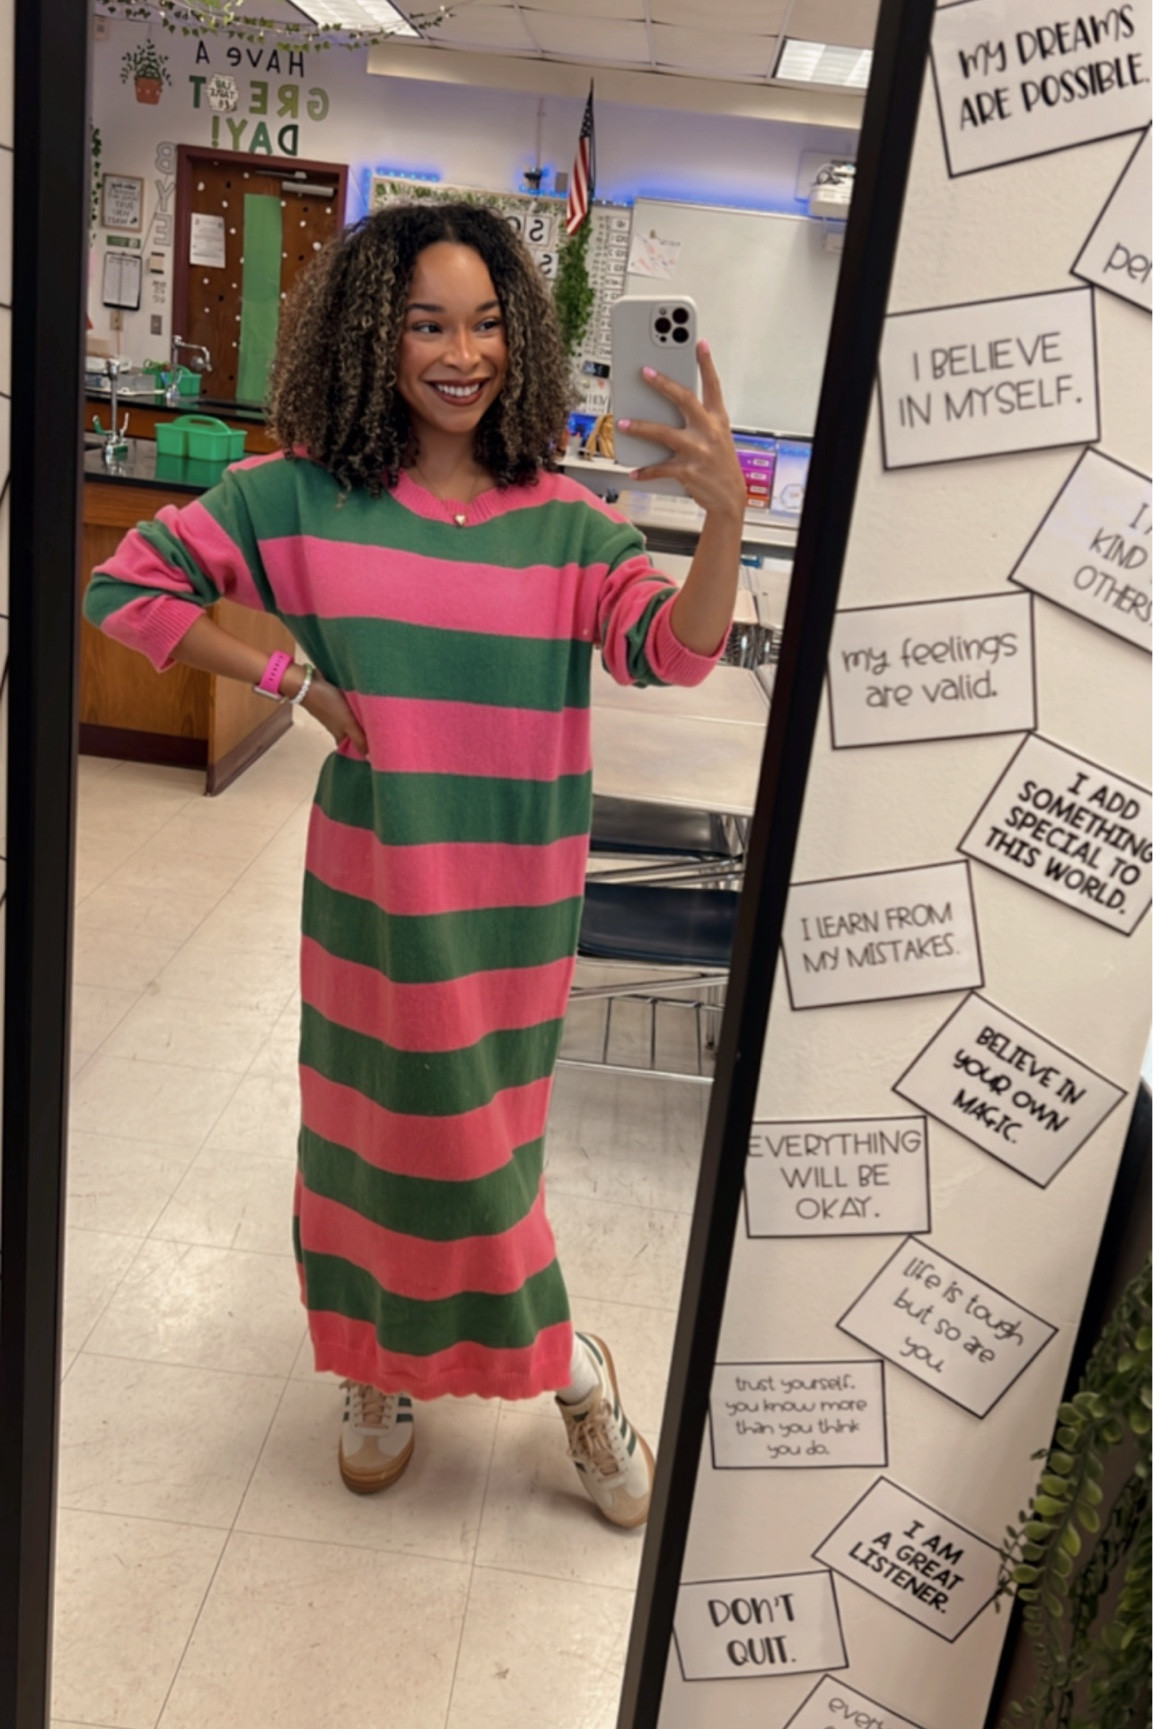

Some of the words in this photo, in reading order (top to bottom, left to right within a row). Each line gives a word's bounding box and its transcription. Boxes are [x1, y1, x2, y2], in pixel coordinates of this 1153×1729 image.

[960, 87, 1012, 130] ARE
[1020, 53, 1151, 112] POSSIBLE.
[913, 352, 920, 381] I
[931, 331, 1062, 380] BELIEVE
[900, 393, 932, 428] IN
[945, 374, 1082, 422] MYSELF.
[1129, 502, 1149, 530] I
[1089, 527, 1148, 569] KIND
[841, 647, 891, 676] my
[900, 632, 1018, 668] feelings
[865, 684, 913, 708] are
[921, 669, 997, 704] valid.
[1067, 771, 1089, 796] I
[1087, 785, 1140, 821] ADD
[1017, 779, 1152, 863] SOMETHING
[1005, 806, 1103, 870] SPECIAL
[1108, 856, 1141, 886] TO
[985, 826, 1041, 868] THIS
[1044, 856, 1126, 915] WORLD.
[801, 917, 811, 941] I
[816, 910, 879, 939] LEARN
[885, 902, 952, 930] FROM
[802, 946, 840, 974] MY
[846, 932, 961, 968] MISTAKES.
[975, 1026, 1061, 1088] BELIEVE
[1055, 1077, 1087, 1105] IN
[952, 1088, 1023, 1144] MAGIC.
[1011, 1090, 1070, 1133] OWN
[748, 1129, 922, 1157] EVERYTHING
[780, 1165, 848, 1189] WILL
[858, 1163, 890, 1187] BE
[795, 1196, 881, 1220] OKAY.
[903, 1257, 942, 1289] life
[942, 1281, 963, 1304] is
[964, 1294, 1023, 1346] tough
[893, 1287, 934, 1325] but
[934, 1318, 961, 1341] so
[963, 1336, 996, 1363] are
[900, 1336, 945, 1374] you
[735, 1376, 775, 1392] trust
[780, 1374, 856, 1394] yourself.
[725, 1401, 759, 1416] you
[763, 1399, 816, 1412] know
[820, 1400, 868, 1411] more
[735, 1420, 775, 1436] than
[778, 1424, 813, 1437] you
[818, 1419, 860, 1434] think
[767, 1444, 801, 1459] you
[805, 1440, 830, 1455] do.
[872, 1531, 892, 1550] A
[895, 1544, 964, 1591] GREAT
[902, 1519, 925, 1539] I
[921, 1534, 965, 1566] AM
[848, 1541, 950, 1614] LISTENER.
[726, 1634, 797, 1667] QUIT.
